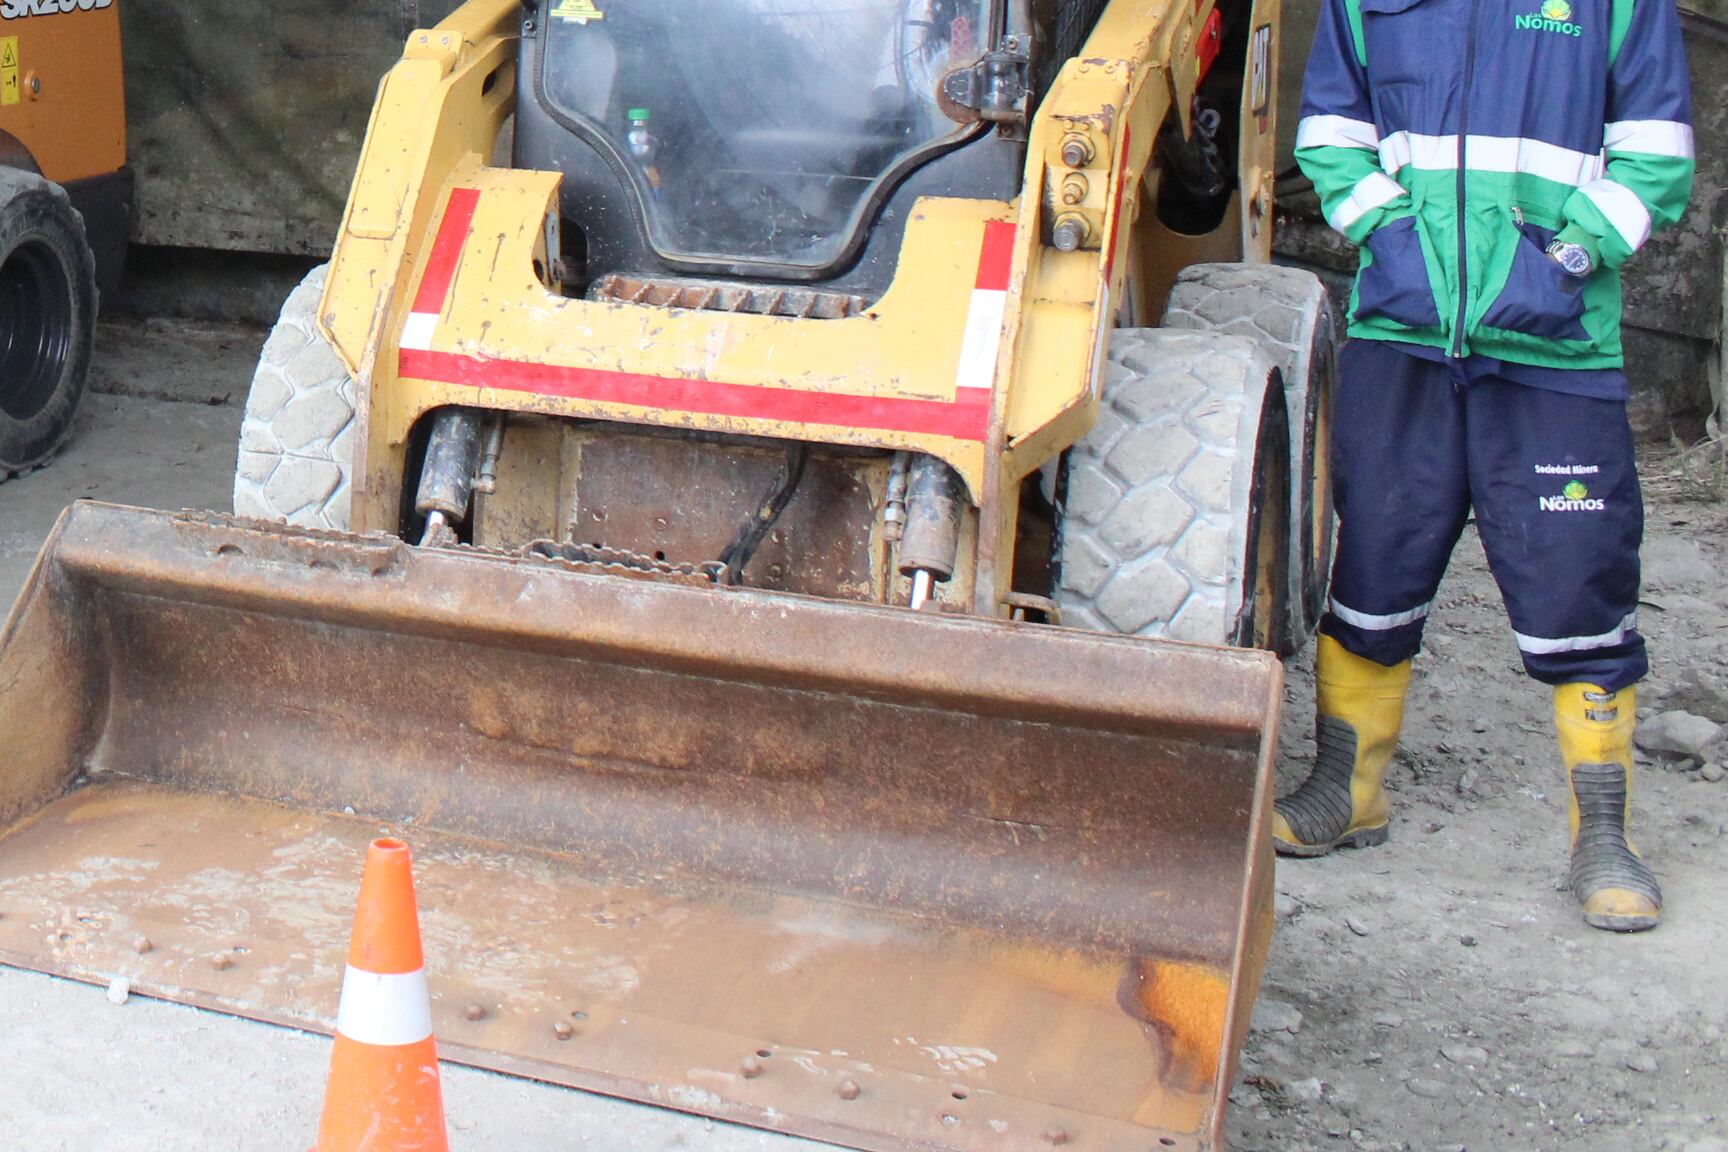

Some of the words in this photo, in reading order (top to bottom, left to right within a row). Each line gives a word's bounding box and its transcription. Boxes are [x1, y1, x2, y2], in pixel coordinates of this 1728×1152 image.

[1515, 14, 1582, 37] Nomos
[1534, 464, 1571, 475] Sociedad
[1572, 465, 1599, 475] Minera
[1539, 496, 1605, 512] Nomos
